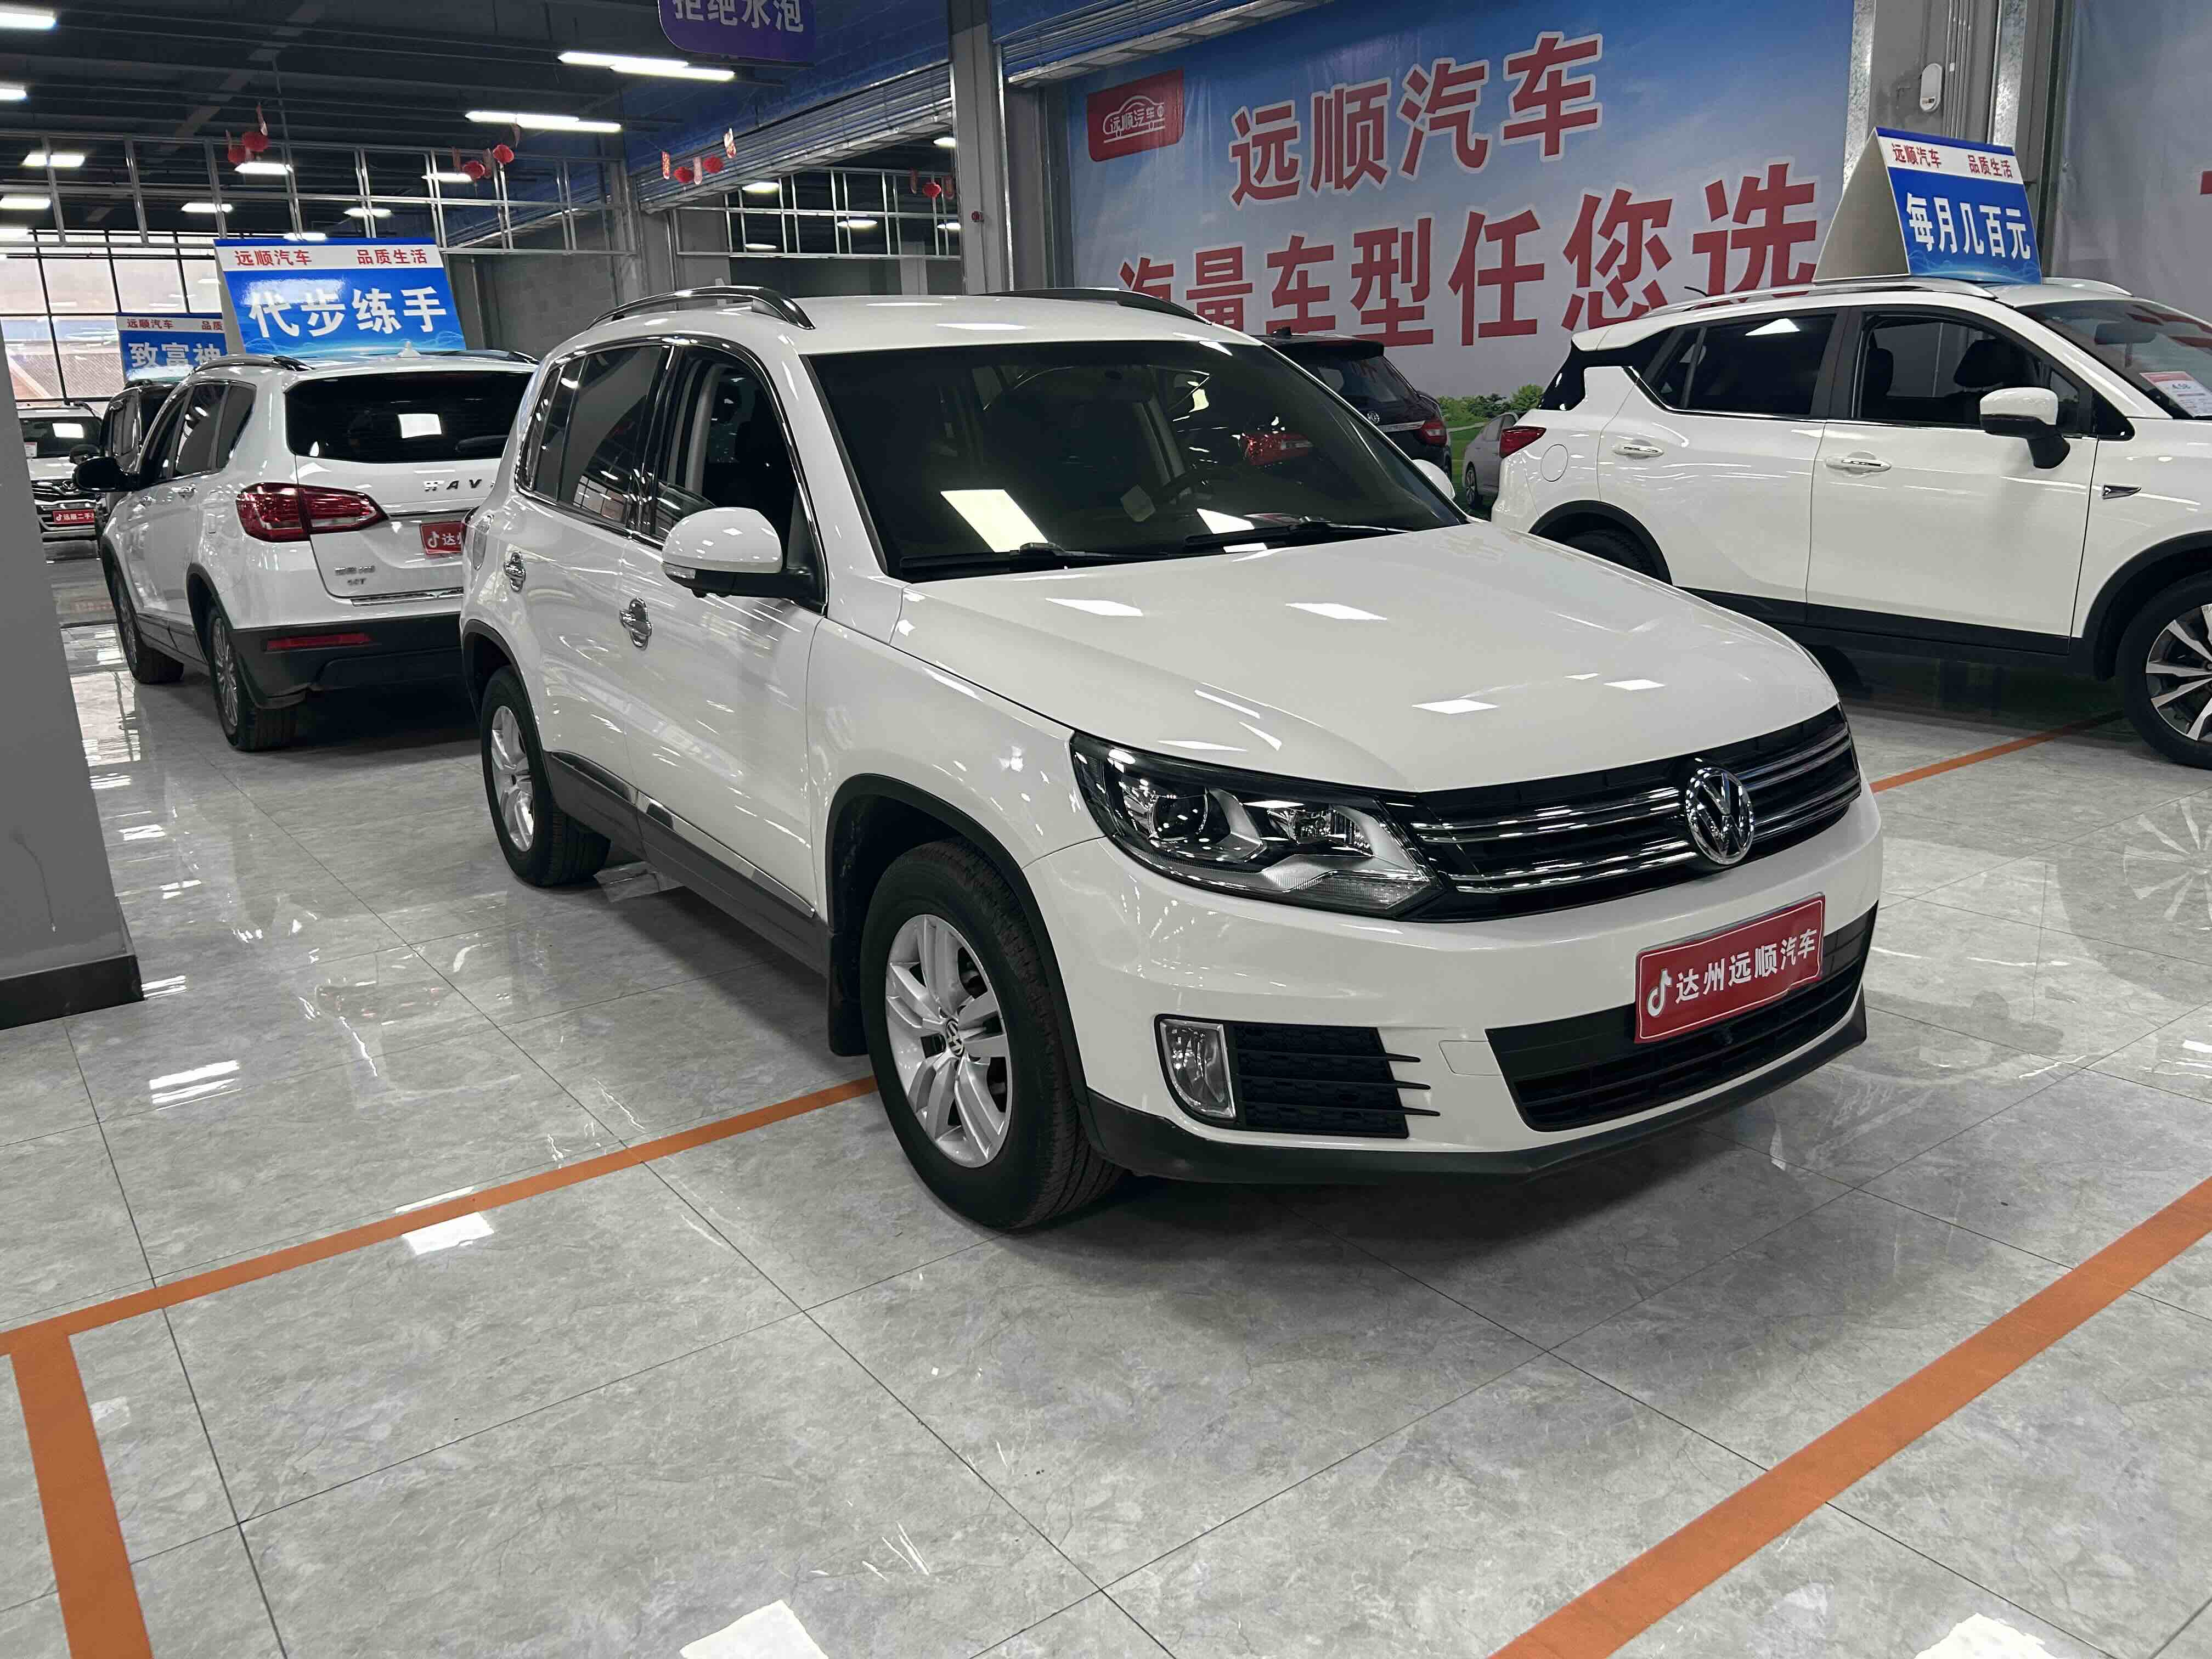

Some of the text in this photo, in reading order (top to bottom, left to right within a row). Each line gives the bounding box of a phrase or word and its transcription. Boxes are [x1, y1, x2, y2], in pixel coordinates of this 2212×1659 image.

[1230, 35, 1600, 208] 远顺汽车
[1891, 142, 2013, 178] 远顺汽车 品质生活
[1906, 192, 2030, 259] 每月几百元
[234, 249, 428, 266] 远顺汽车 品质生活
[127, 319, 174, 329] 远顺汽车
[249, 286, 447, 338] 代步练手
[424, 478, 495, 492] HAV
[1675, 928, 1818, 1004] 达州远顺汽车
